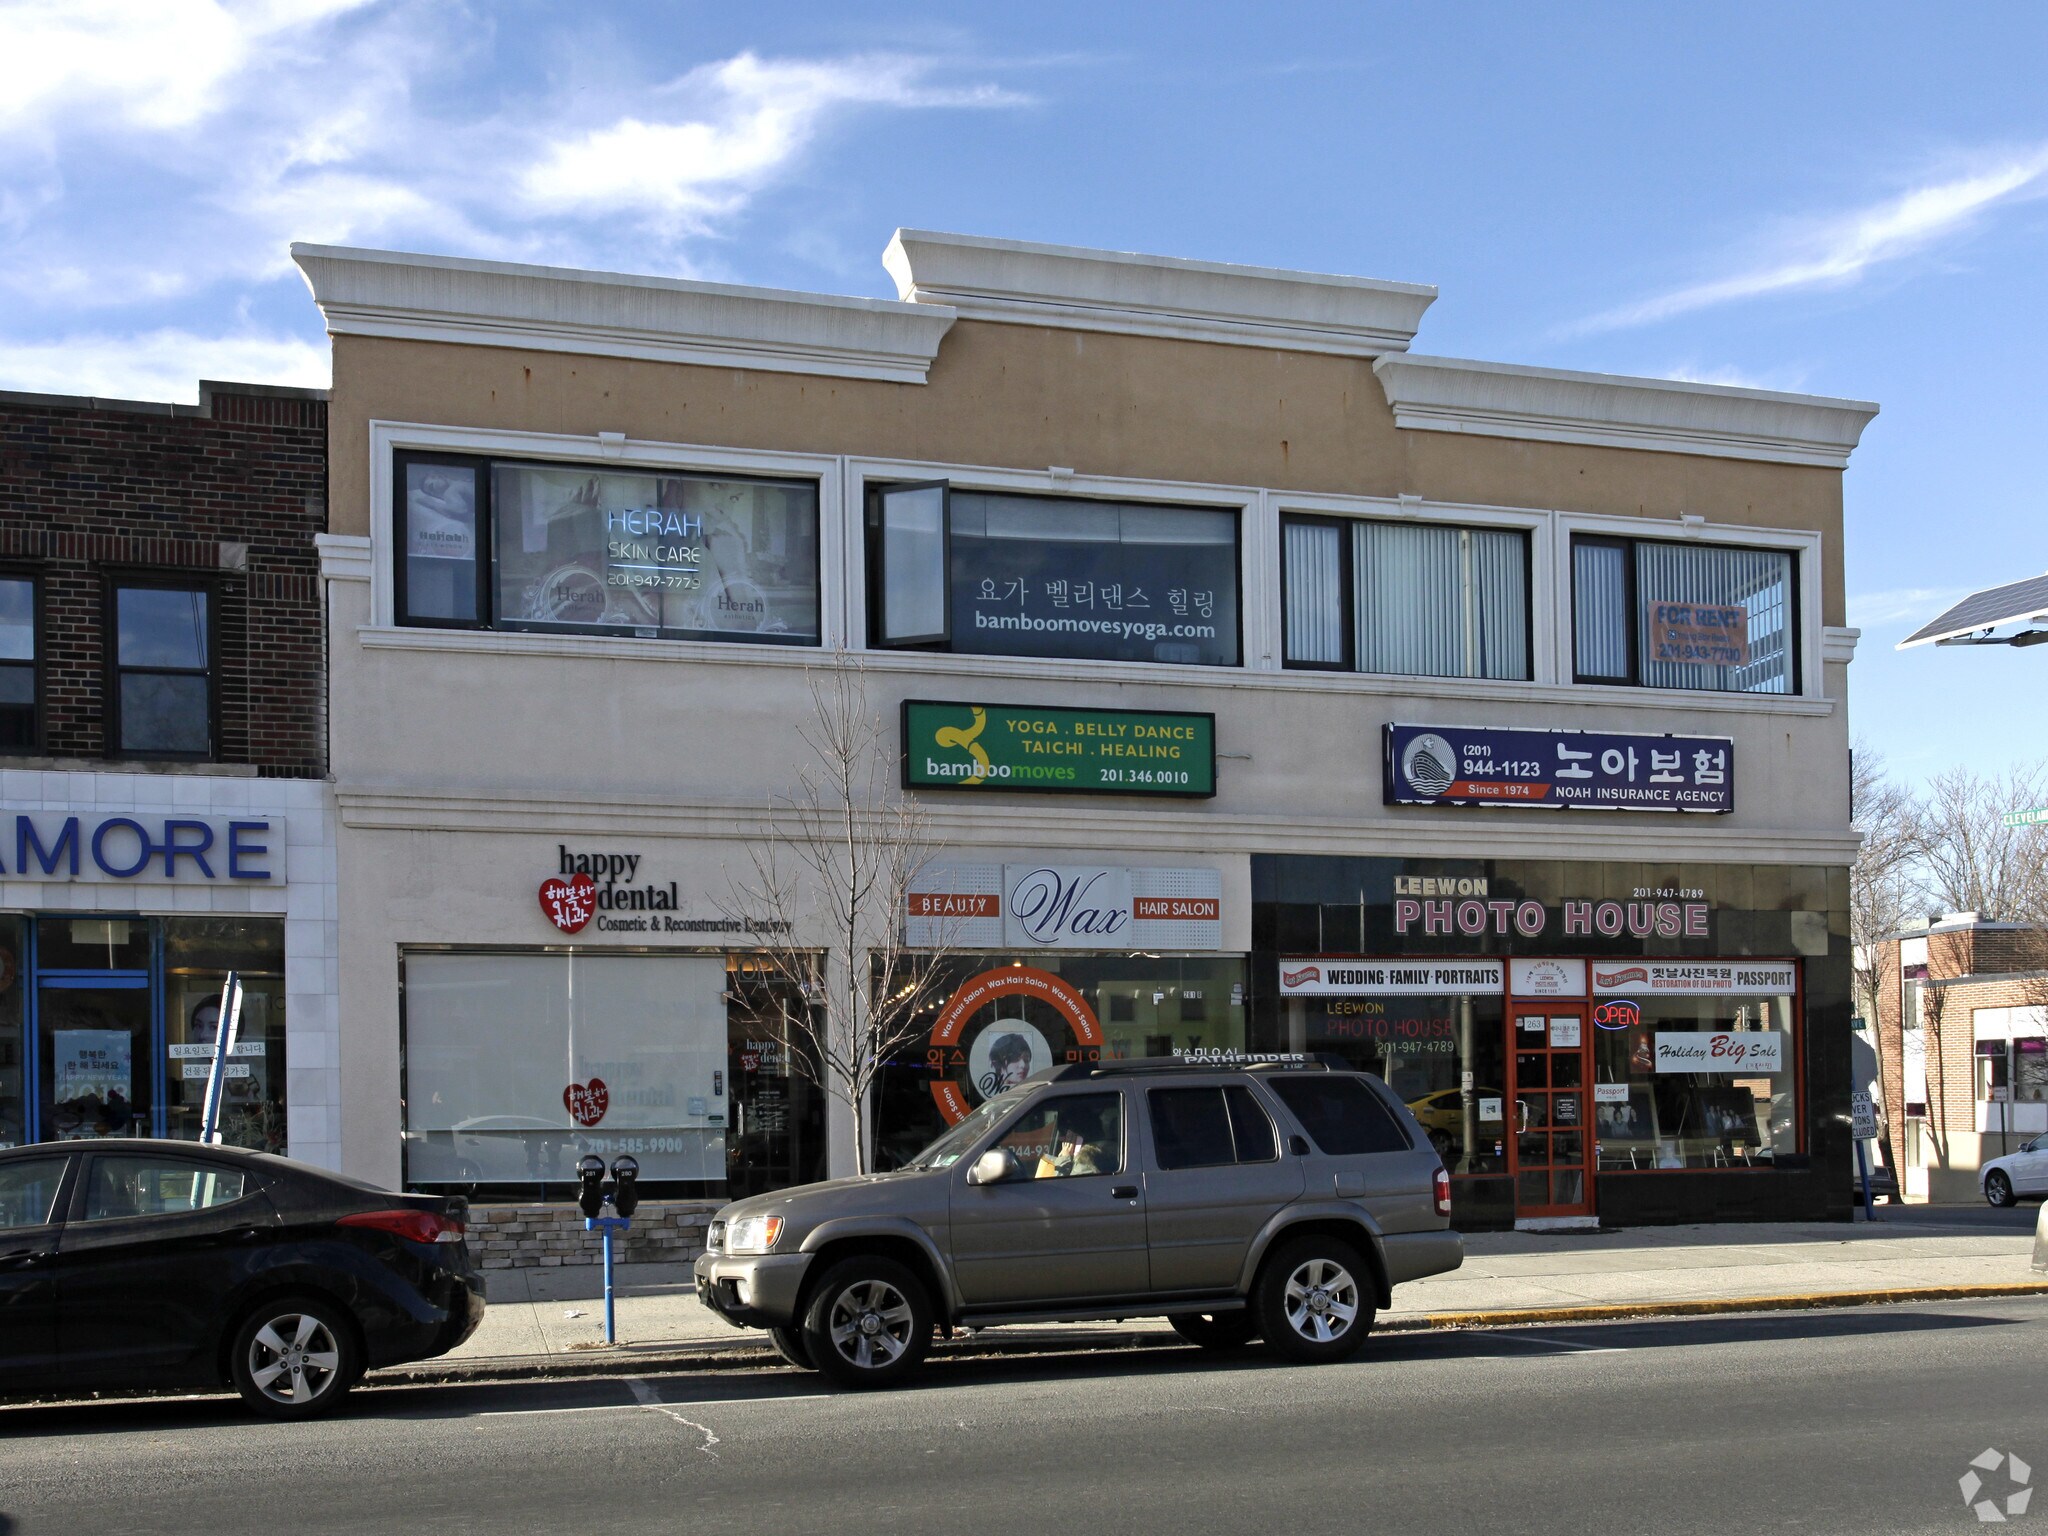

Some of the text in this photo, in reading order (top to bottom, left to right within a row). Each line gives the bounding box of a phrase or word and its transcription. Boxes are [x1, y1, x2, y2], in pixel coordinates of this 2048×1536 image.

[608, 509, 702, 538] HERAH
[608, 542, 700, 563] SKIN CARE
[607, 574, 700, 590] 201-947-7779
[557, 586, 605, 603] Herah
[975, 577, 1214, 618] 요가 벨리댄스 힐링
[717, 596, 764, 613] Herah
[975, 611, 1216, 640] bamboomovesyoga.com
[1658, 606, 1740, 628] FOR RENT
[1006, 720, 1195, 740] YOGA BELLY DANCE
[1022, 740, 1181, 759] TAICHI HEALING
[1463, 744, 1492, 758] (201)
[926, 758, 1076, 780] bamboomoves
[1463, 760, 1541, 778] 944-1123
[1555, 742, 1725, 785] 노아보험
[1100, 768, 1189, 785] 201.346.0010
[1468, 784, 1530, 796] Since 1974
[1555, 786, 1725, 803] NOAH INSURANCE AGENCY
[2003, 809, 2048, 826] CLEVELAN
[0, 815, 271, 879] MORE
[559, 845, 640, 883] happy
[1395, 878, 1488, 895] LEEWON
[1633, 887, 1704, 899] 201-947-4789
[545, 885, 594, 910] 행복한
[598, 882, 680, 911] dental
[922, 897, 987, 913] BEAUTY
[1009, 868, 1128, 944] Wax
[1139, 902, 1214, 916] HAIR SALON
[552, 902, 589, 928] 치과
[1395, 900, 1708, 936] PHOTO HOUSE
[598, 916, 648, 932] Cosmetic
[651, 916, 661, 931] &
[664, 916, 742, 933] Reconstructive
[987, 976, 1048, 990] Wax Hair Salon
[1327, 969, 1499, 985] WEDDING FAMILY PORTRAITS
[1652, 979, 1732, 988] RESTORATION OF OLD PHOTO
[1737, 971, 1792, 985] PASSPORT
[941, 986, 985, 1038] Wax Hair Salon
[1051, 986, 1093, 1040] Wax Hair Salon
[1327, 1002, 1384, 1015] LEEWON
[1594, 1005, 1640, 1026] OPEN
[1327, 1018, 1453, 1037] PHOTO HOUSE
[1527, 1020, 1541, 1029] 263
[79, 1050, 106, 1059] 행복한
[746, 1038, 777, 1054] happy
[1377, 1040, 1454, 1053] 201-947-4789
[1658, 1034, 1777, 1065] Holiday Big Sale
[68, 1061, 76, 1070] 한
[80, 1061, 88, 1070] 해
[760, 1051, 790, 1063] dental
[927, 1049, 967, 1078] 왁스
[1184, 1054, 1305, 1064] PATHFINDER
[979, 1071, 1014, 1098] Wa
[1597, 1087, 1626, 1096] Passport
[943, 1087, 958, 1112] Salon
[1852, 1103, 1867, 1114] VER
[1854, 1115, 1871, 1125] TONS
[1852, 1126, 1875, 1137] CLUDED
[588, 1137, 682, 1153] 201-585-9900
